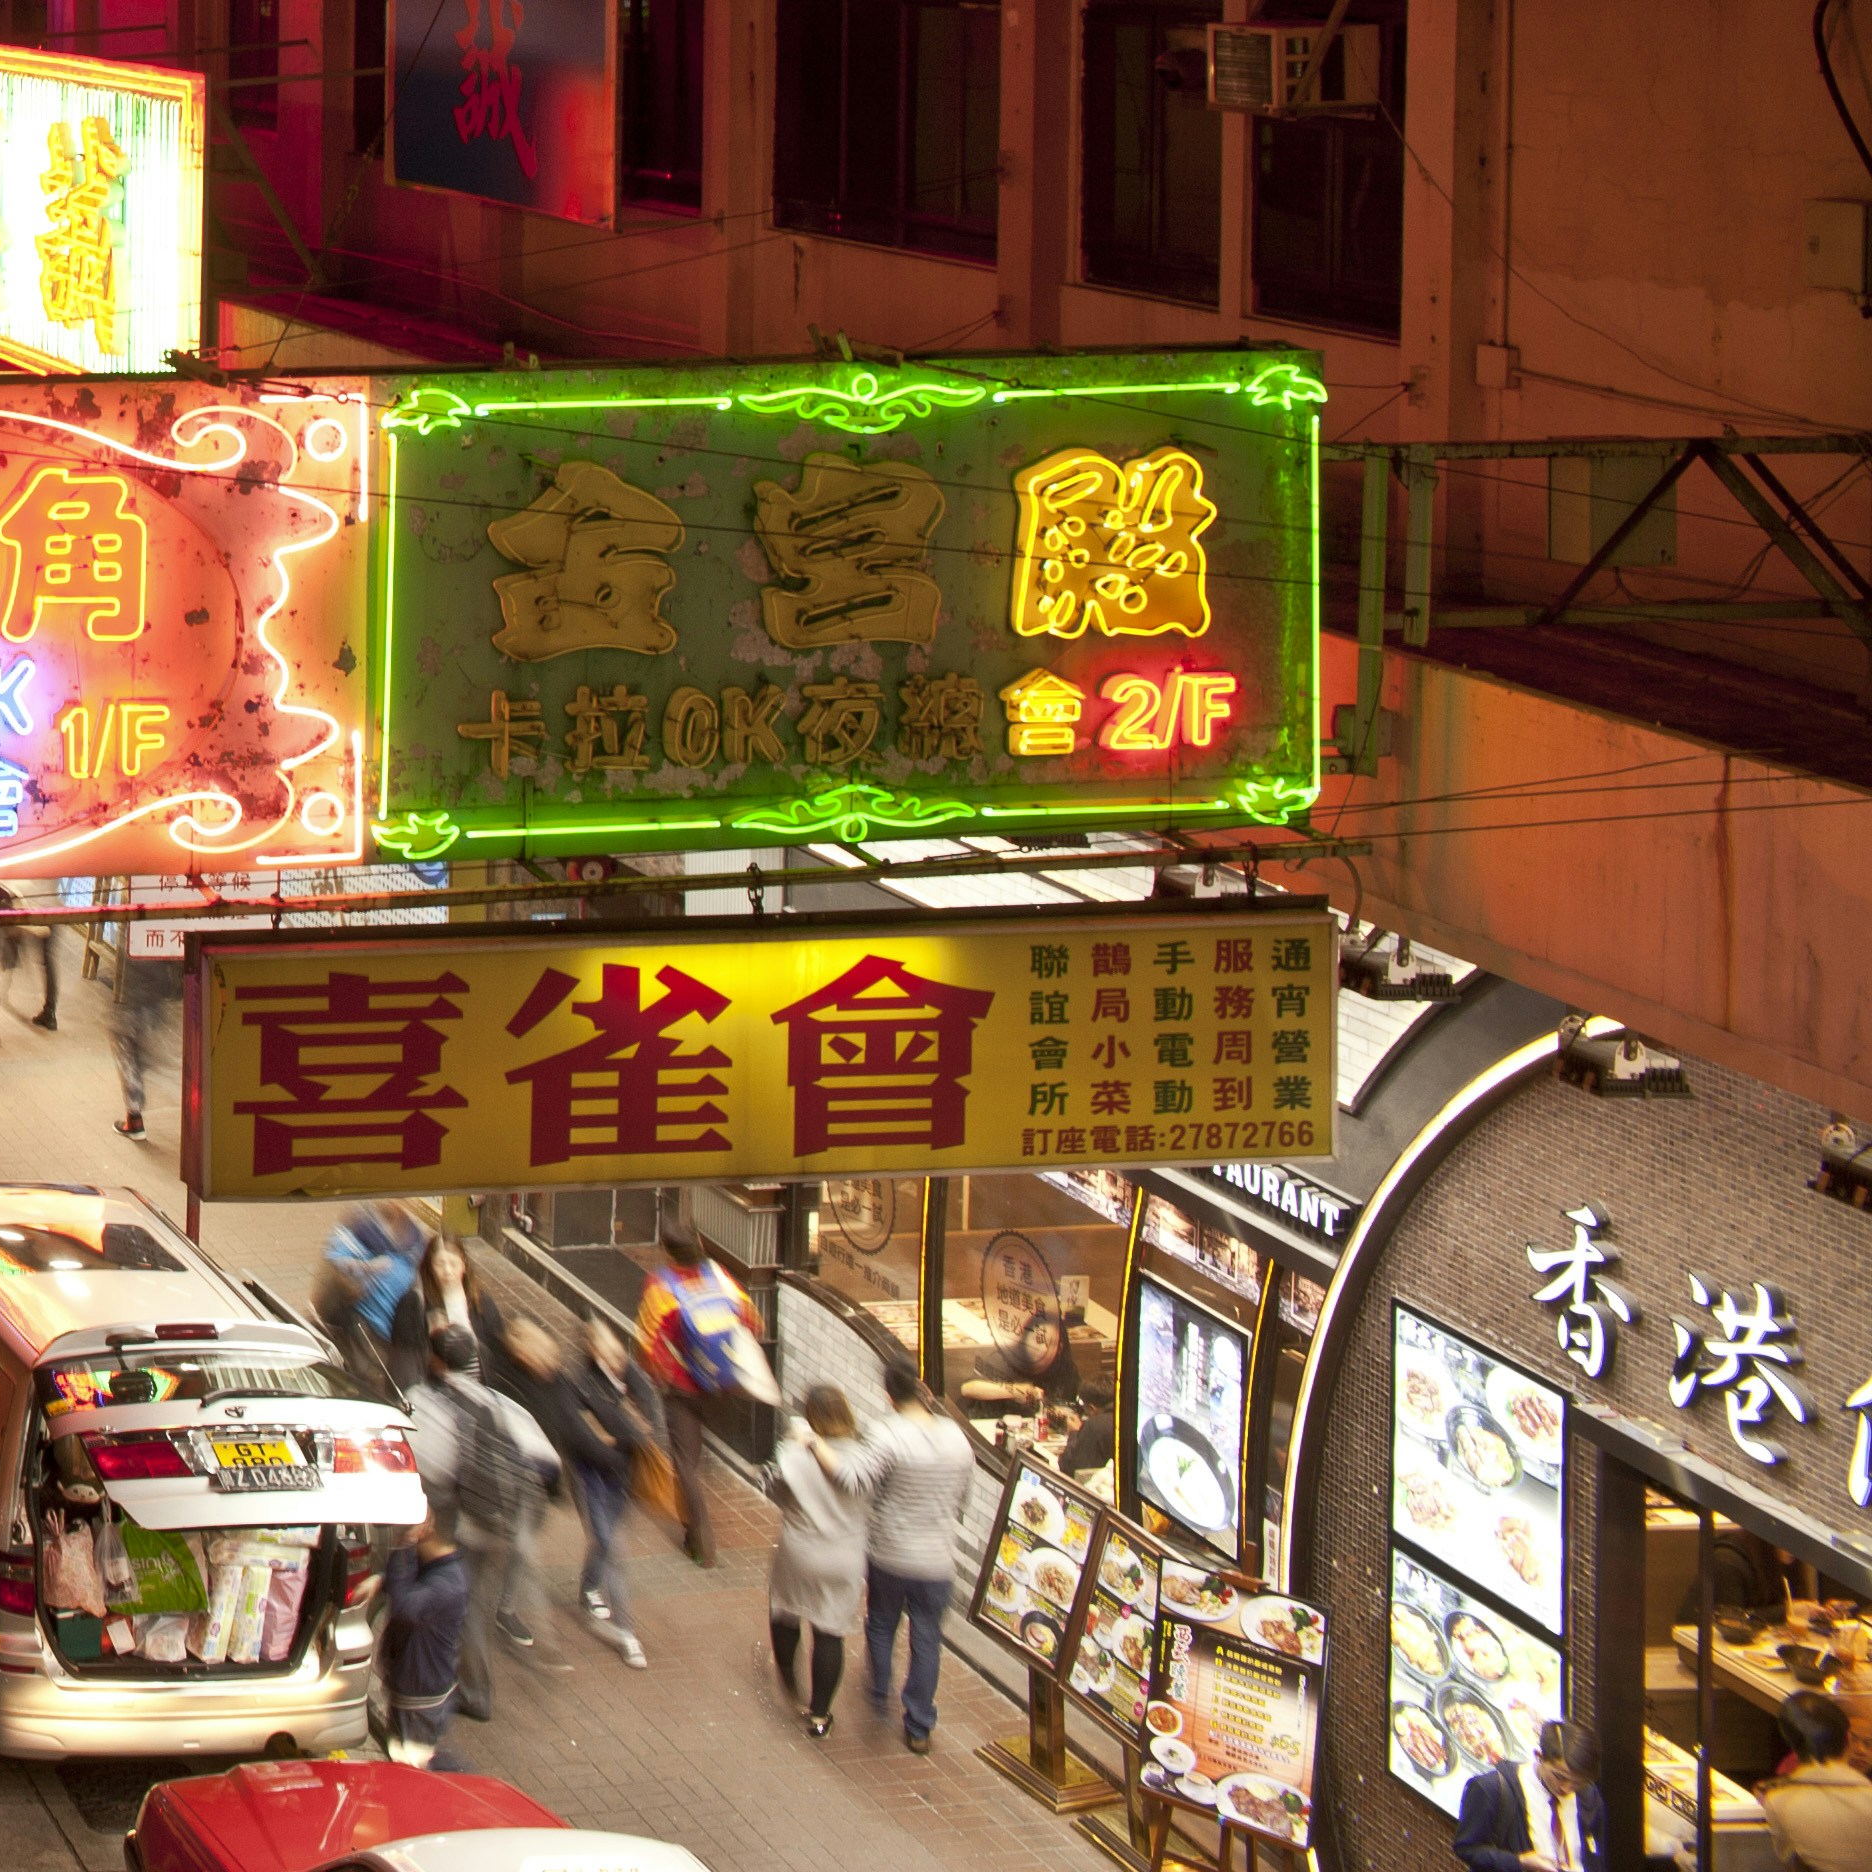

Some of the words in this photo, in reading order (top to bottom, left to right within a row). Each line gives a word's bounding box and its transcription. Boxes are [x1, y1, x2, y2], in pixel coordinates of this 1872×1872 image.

[60, 703, 169, 781] 1/F
[1105, 670, 1238, 751] 2/F
[232, 954, 996, 1179] 喜雀會
[1029, 943, 1069, 1116] 聯誼會所
[1153, 941, 1196, 1114] 手動電動
[1213, 938, 1255, 1113] 服務周到
[1272, 937, 1314, 1110] 通宵營業
[997, 1282, 1048, 1322] 地道美食
[1003, 1254, 1033, 1286] 香港
[235, 1443, 266, 1457] GT
